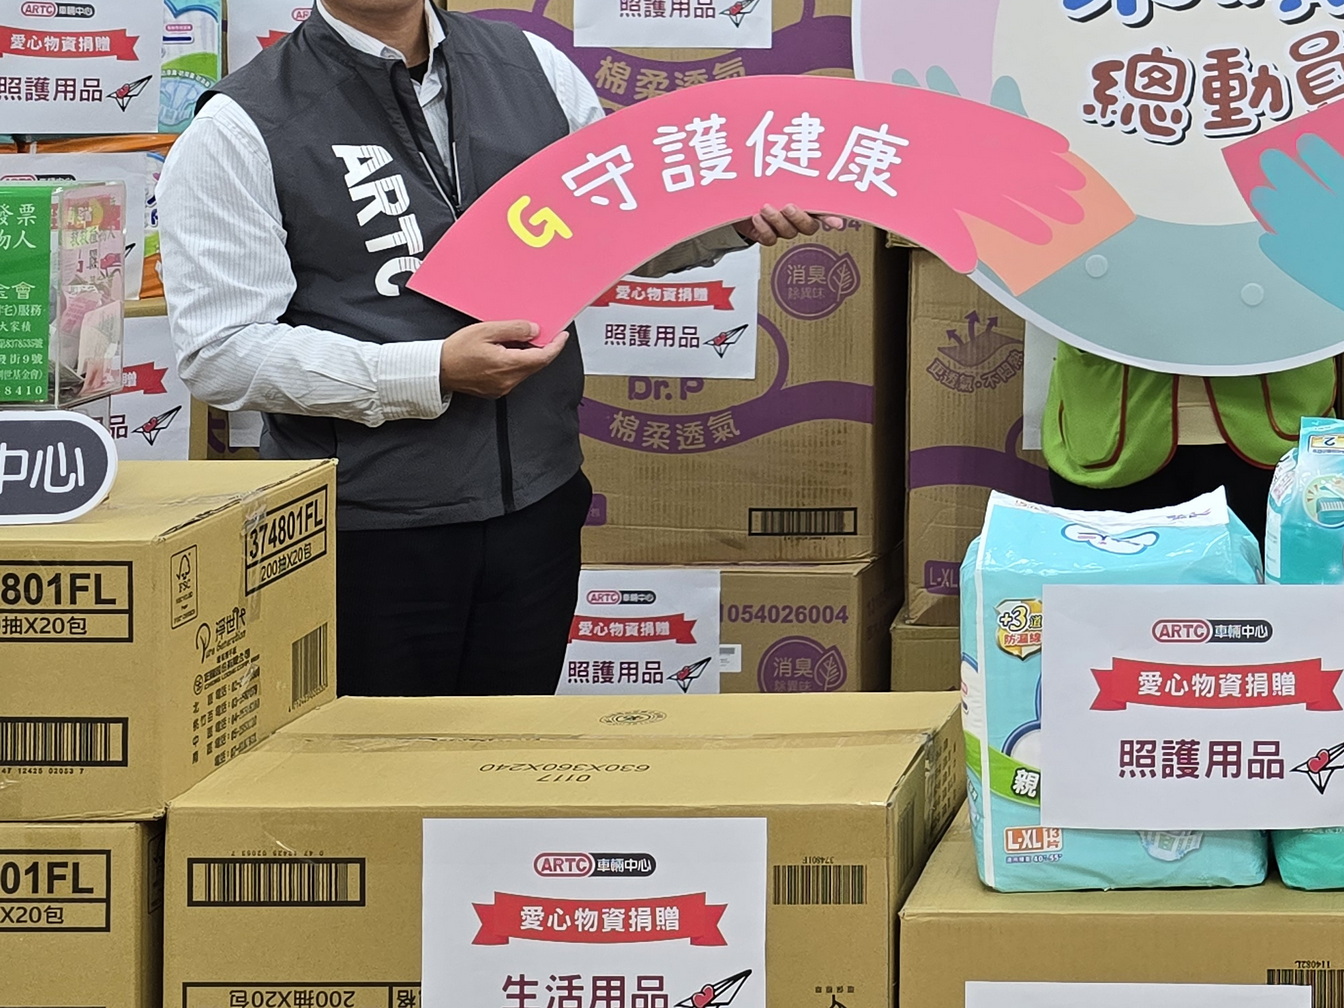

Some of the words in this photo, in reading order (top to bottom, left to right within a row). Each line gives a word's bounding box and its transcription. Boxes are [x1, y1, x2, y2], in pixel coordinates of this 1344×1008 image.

[24, 3, 54, 14] ARTC
[9, 33, 111, 53] 愛心物資捐贈
[0, 76, 103, 103] 照護用品
[331, 144, 424, 297] ARTC
[786, 264, 827, 285] 消臭
[614, 285, 709, 303] 愛心物資捐贈
[604, 323, 701, 349] 照護用品
[609, 412, 741, 451] 棉柔透氣
[249, 499, 323, 559] 374801FL
[1, 573, 117, 606] 801FL
[590, 593, 618, 602] ARTC
[577, 620, 671, 637] 愛心物資捐贈
[1158, 623, 1206, 639] ARTC
[1214, 624, 1269, 639] 車輛中心
[567, 659, 664, 685] 照護用品
[773, 656, 813, 678] 消臭
[1137, 671, 1297, 698] 愛心物資捐贈
[1118, 739, 1285, 780] 照護用品
[536, 773, 591, 783] 0117
[541, 856, 589, 873] ARTC
[519, 905, 681, 932] 愛心物資捐贈
[501, 973, 670, 1008] 生活用品
